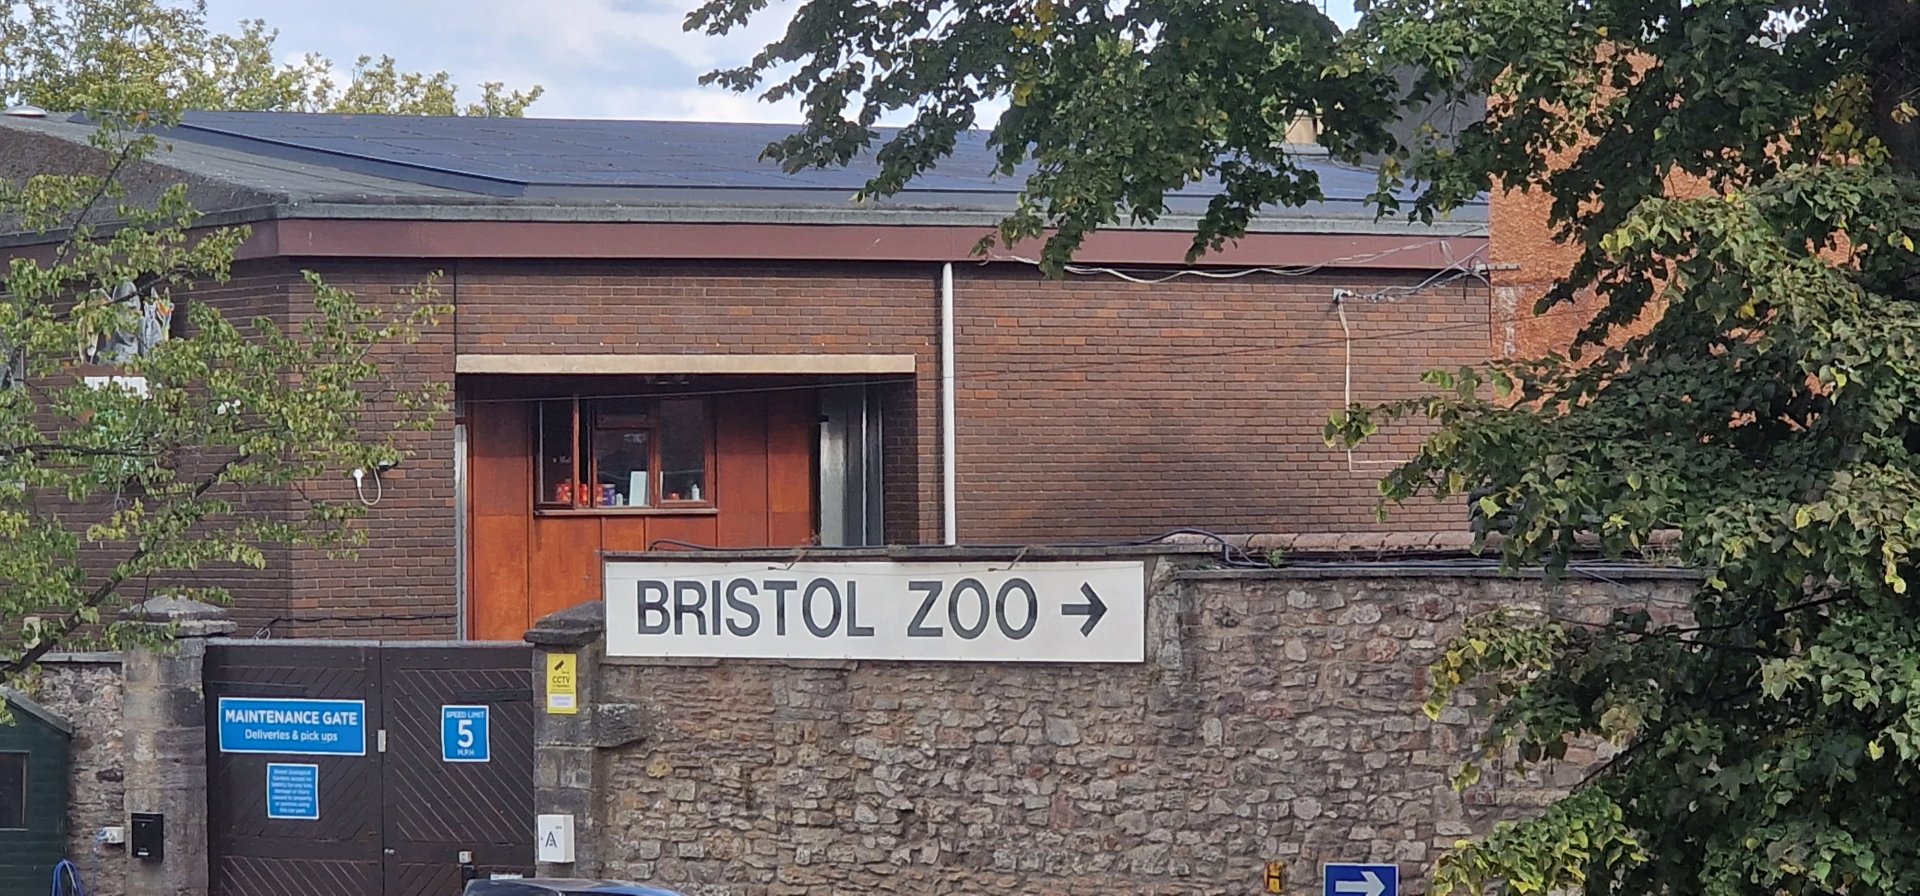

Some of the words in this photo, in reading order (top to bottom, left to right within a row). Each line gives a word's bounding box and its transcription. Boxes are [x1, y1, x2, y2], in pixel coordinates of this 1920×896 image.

[636, 577, 875, 638] BRISTOL
[907, 577, 1039, 641] ZOO
[552, 675, 571, 684] CCTV
[225, 709, 320, 724] MAINTENANCE
[322, 711, 358, 725] GATE
[446, 711, 467, 719] SPEED
[468, 711, 485, 719] LIMIT
[245, 729, 291, 741] Deliveries
[292, 730, 299, 741] &
[300, 730, 320, 742] pick
[321, 733, 338, 743] ups
[457, 719, 474, 748] 5
